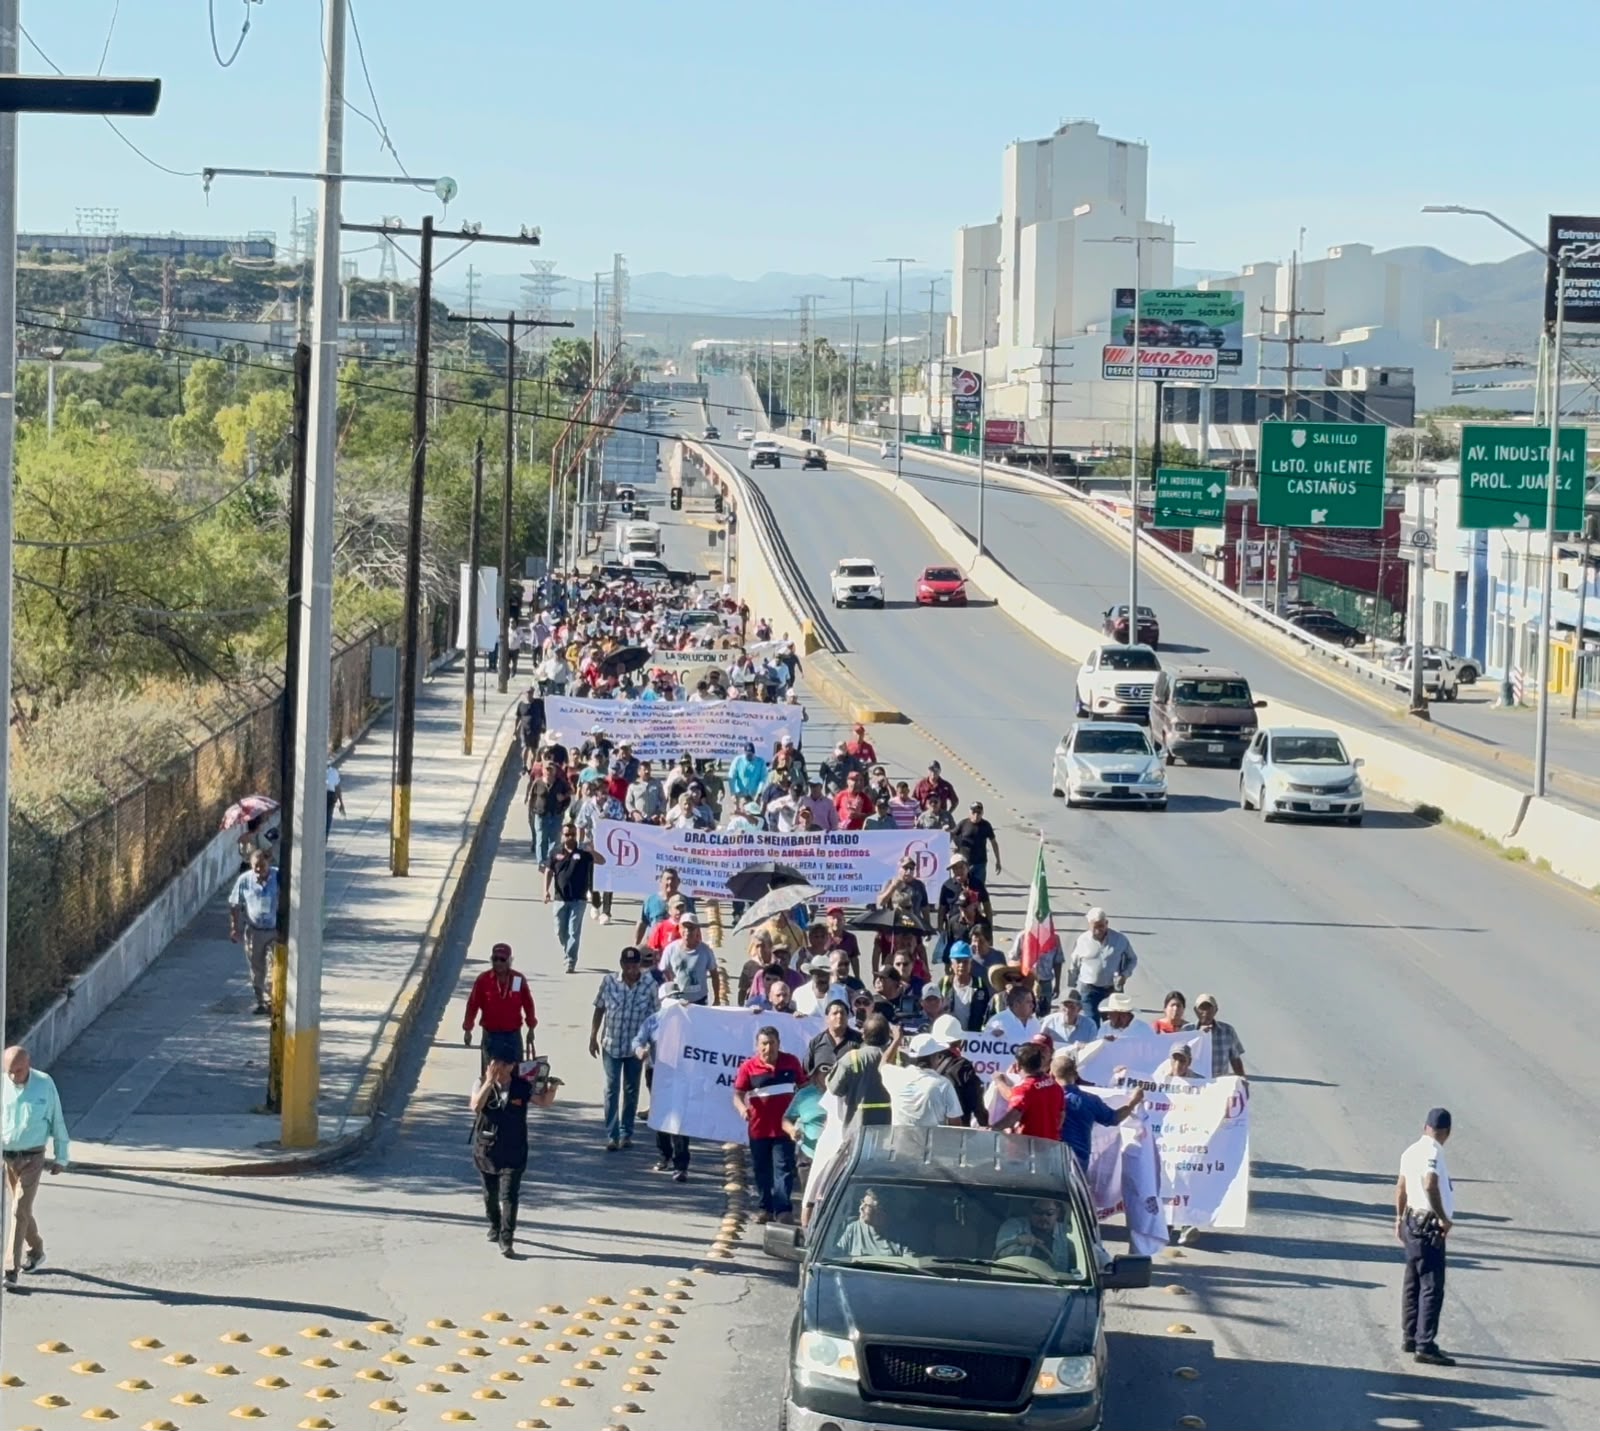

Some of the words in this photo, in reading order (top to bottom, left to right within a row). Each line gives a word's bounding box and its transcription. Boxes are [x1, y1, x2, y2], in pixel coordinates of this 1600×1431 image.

[1557, 229, 1593, 239] Estrena
[1130, 349, 1213, 365] AutoZone
[1108, 366, 1157, 377] REFACONES
[1160, 368, 1166, 377] Y
[1169, 369, 1213, 378] ACCESORIOS
[1467, 445, 1488, 461] AV.
[1314, 460, 1373, 475] ORIENTE
[1287, 477, 1356, 495] CASTAÑOS
[1470, 472, 1511, 489] PROL.
[824, 834, 859, 845] PARDO
[656, 853, 685, 864] RESCATE
[690, 846, 765, 857] extrabajadores
[828, 848, 870, 858] pedimos
[827, 873, 836, 881] DE
[851, 884, 883, 892] INDIRECT
[683, 1045, 719, 1065] ESTE
[1206, 1163, 1213, 1175] y
[1215, 1160, 1225, 1172] la
